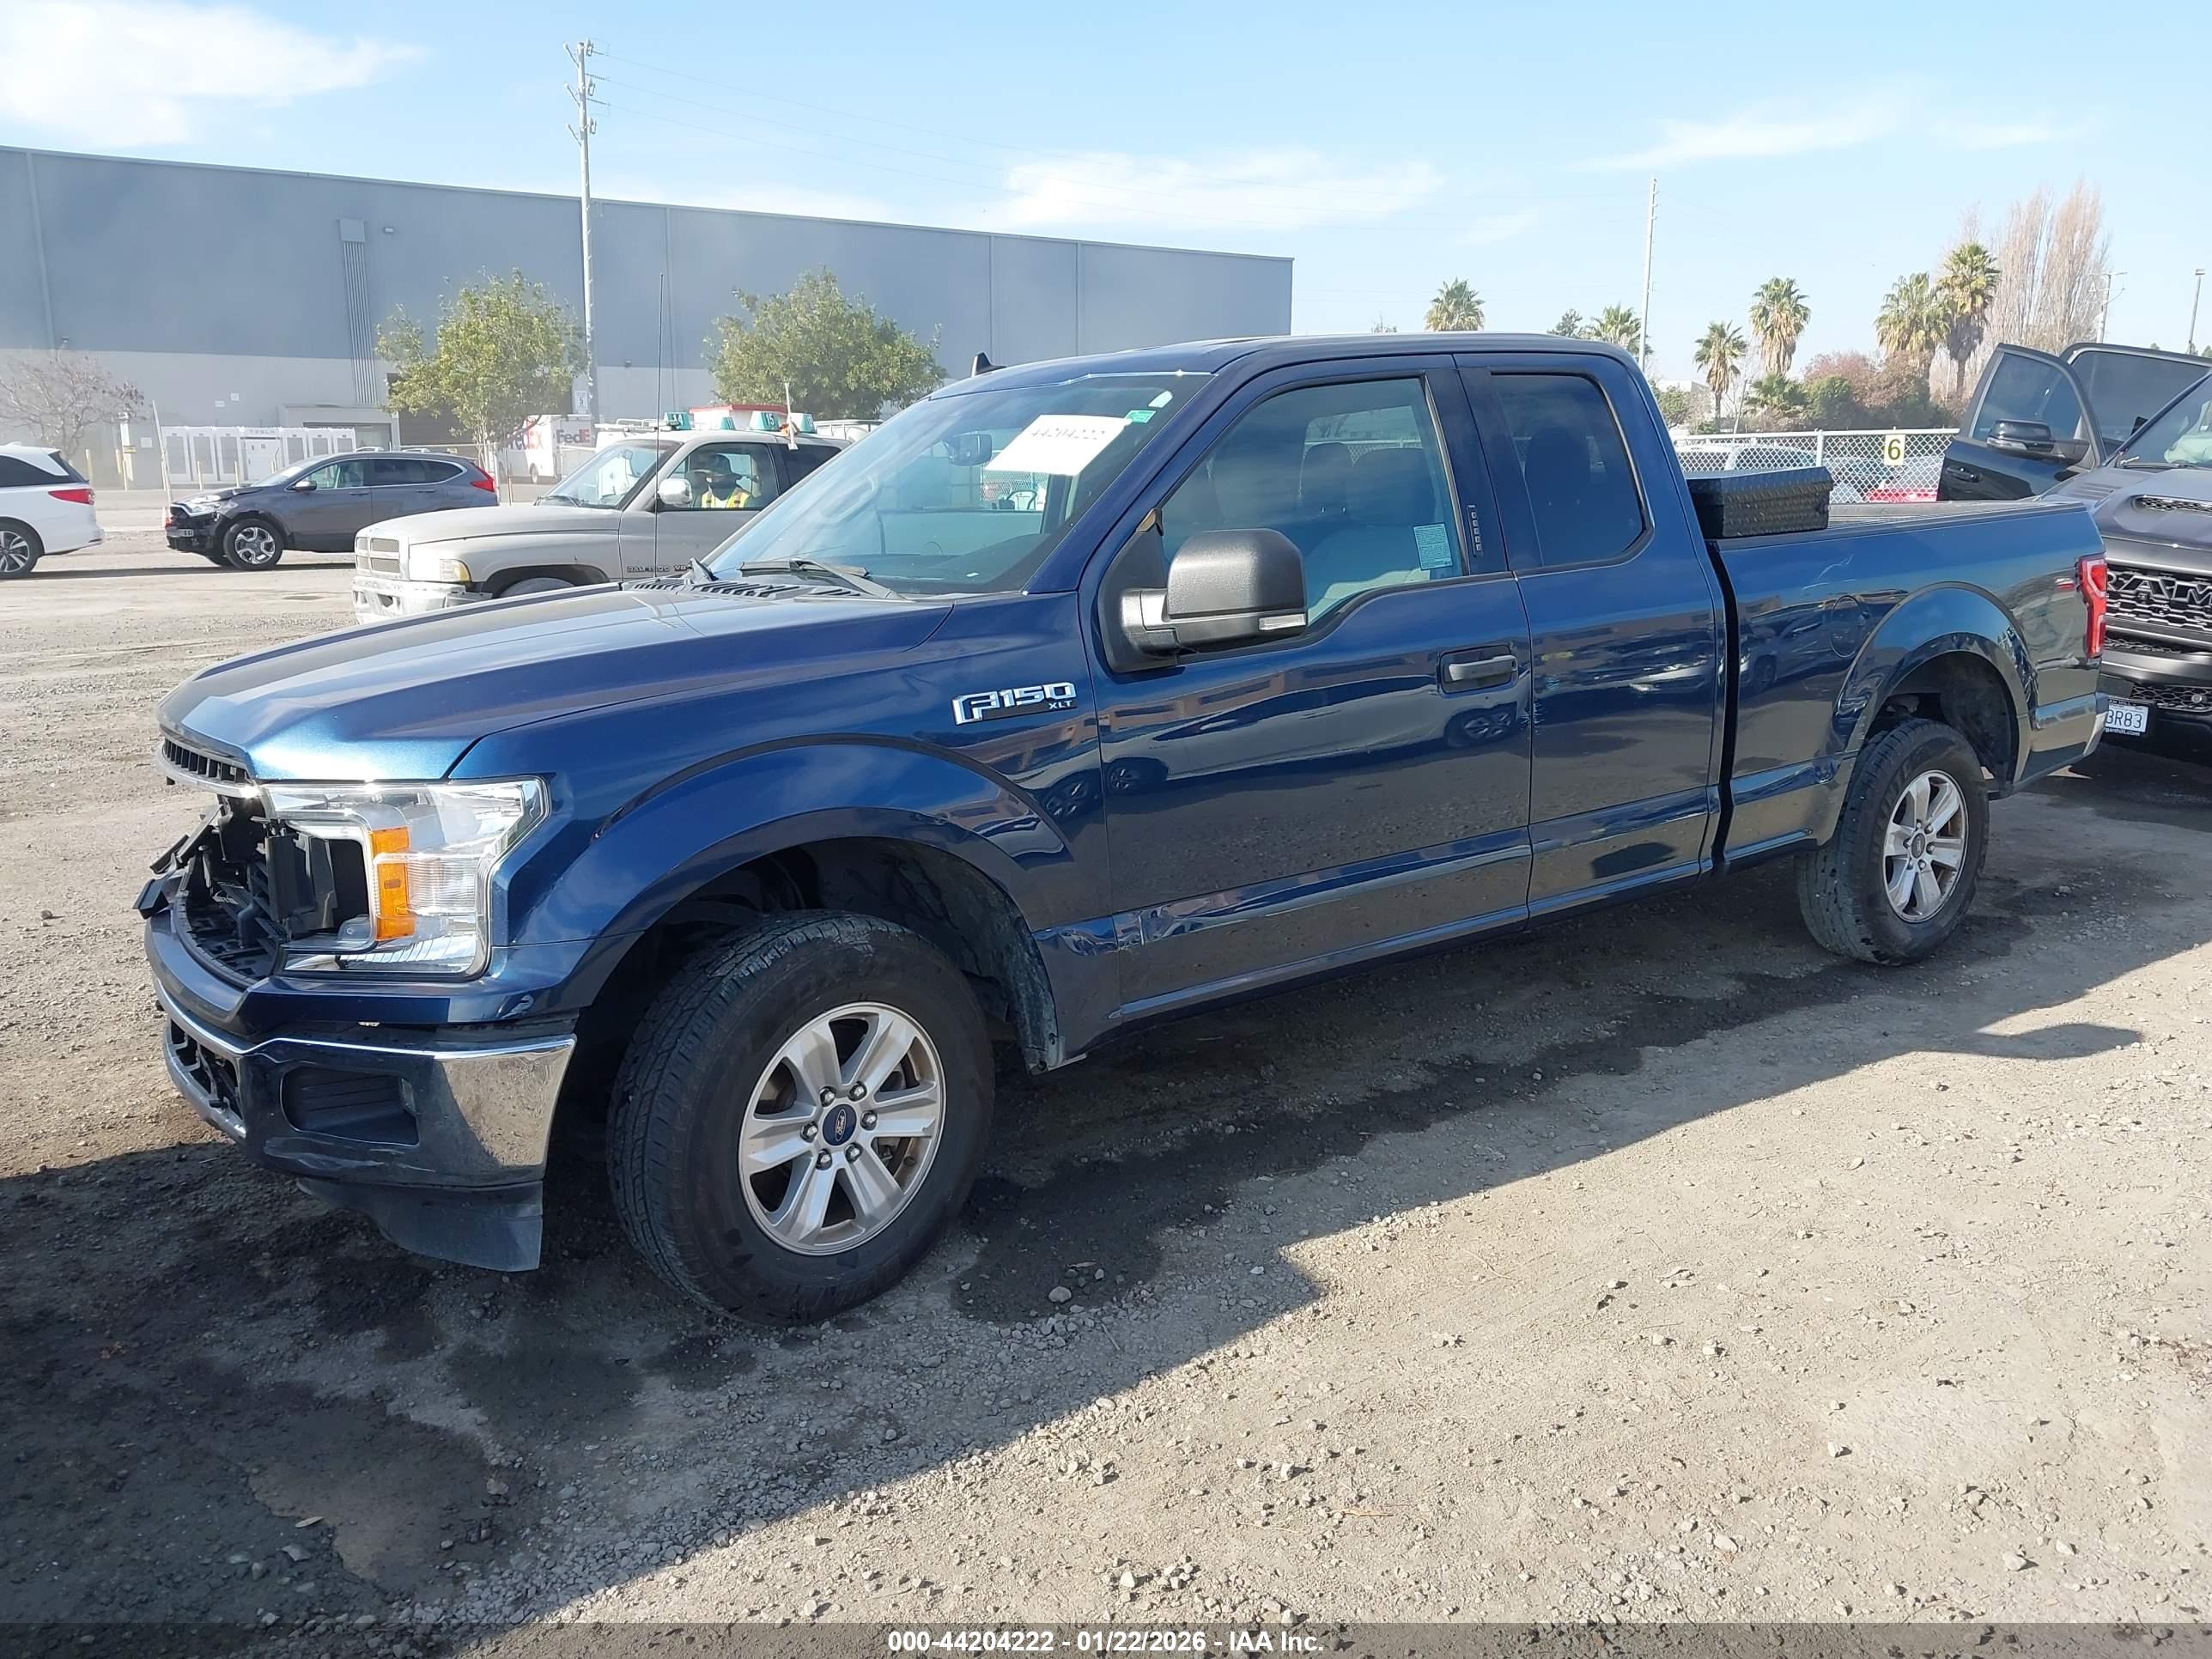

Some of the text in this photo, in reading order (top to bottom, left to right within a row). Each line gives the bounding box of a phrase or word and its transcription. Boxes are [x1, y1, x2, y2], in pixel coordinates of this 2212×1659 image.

[765, 413, 775, 426] 15
[1887, 438, 1901, 460] 6
[1048, 700, 1073, 709] XLT
[2106, 709, 2142, 729] 3R83
